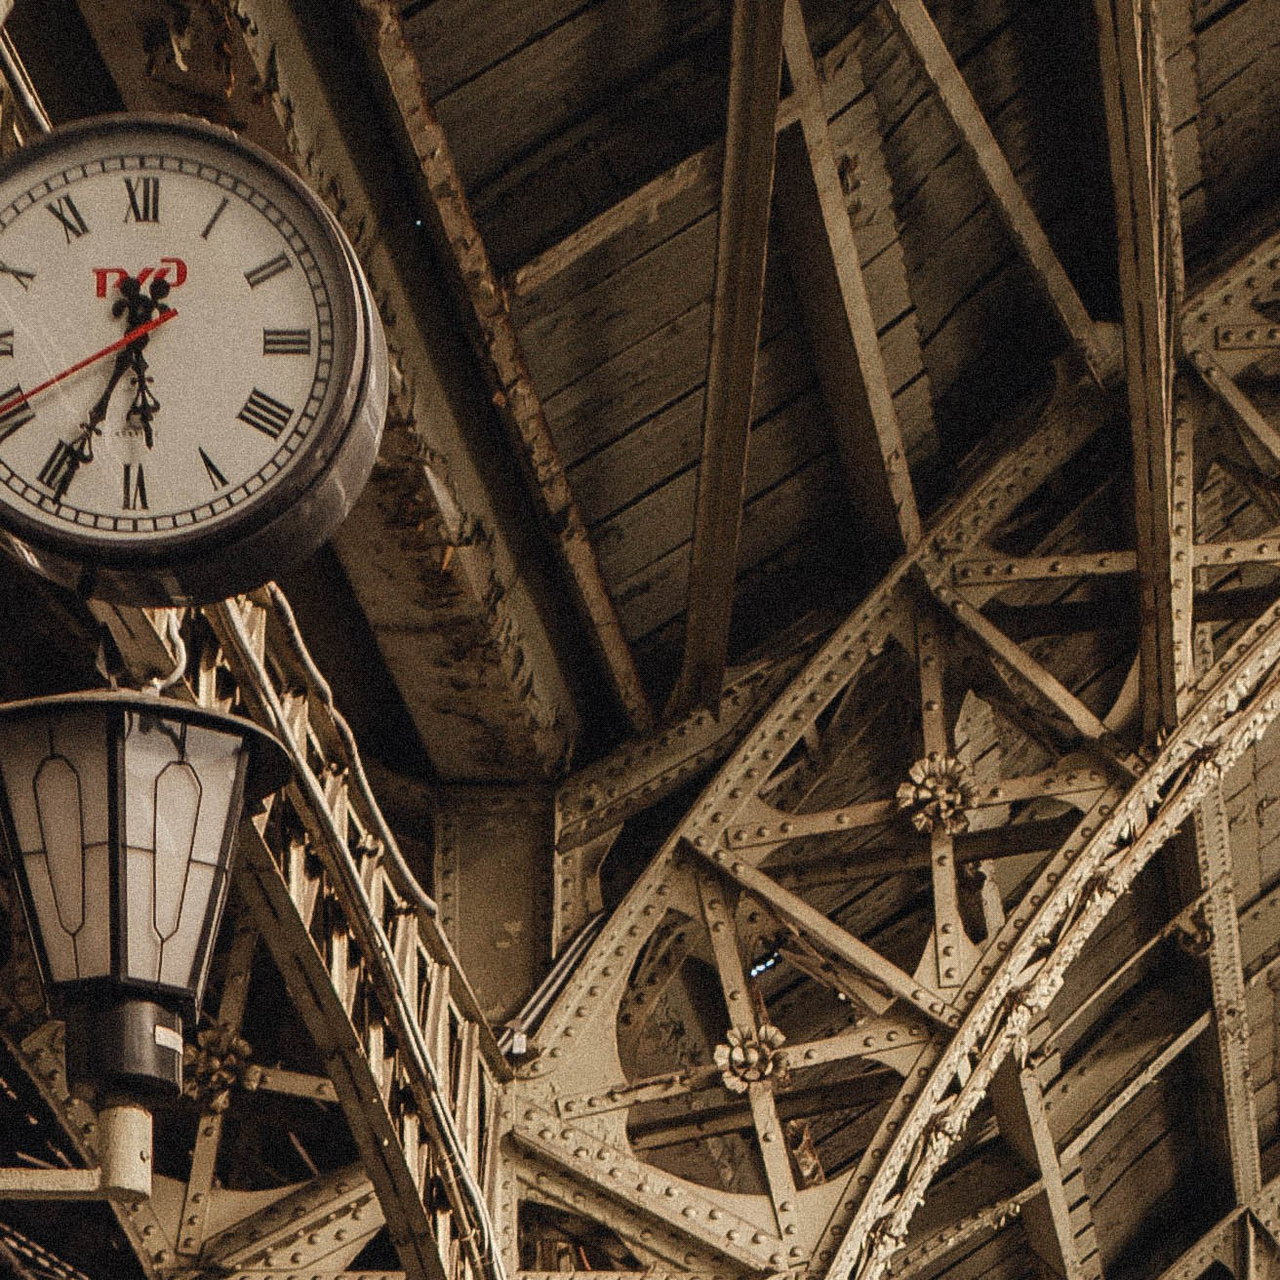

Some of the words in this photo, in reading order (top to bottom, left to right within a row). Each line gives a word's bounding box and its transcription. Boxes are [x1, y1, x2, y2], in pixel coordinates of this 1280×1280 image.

[45, 194, 90, 244] XI
[124, 176, 160, 225] XII
[200, 197, 229, 240] I
[243, 251, 293, 290] II
[263, 327, 311, 356] III
[122, 463, 149, 510] VI
